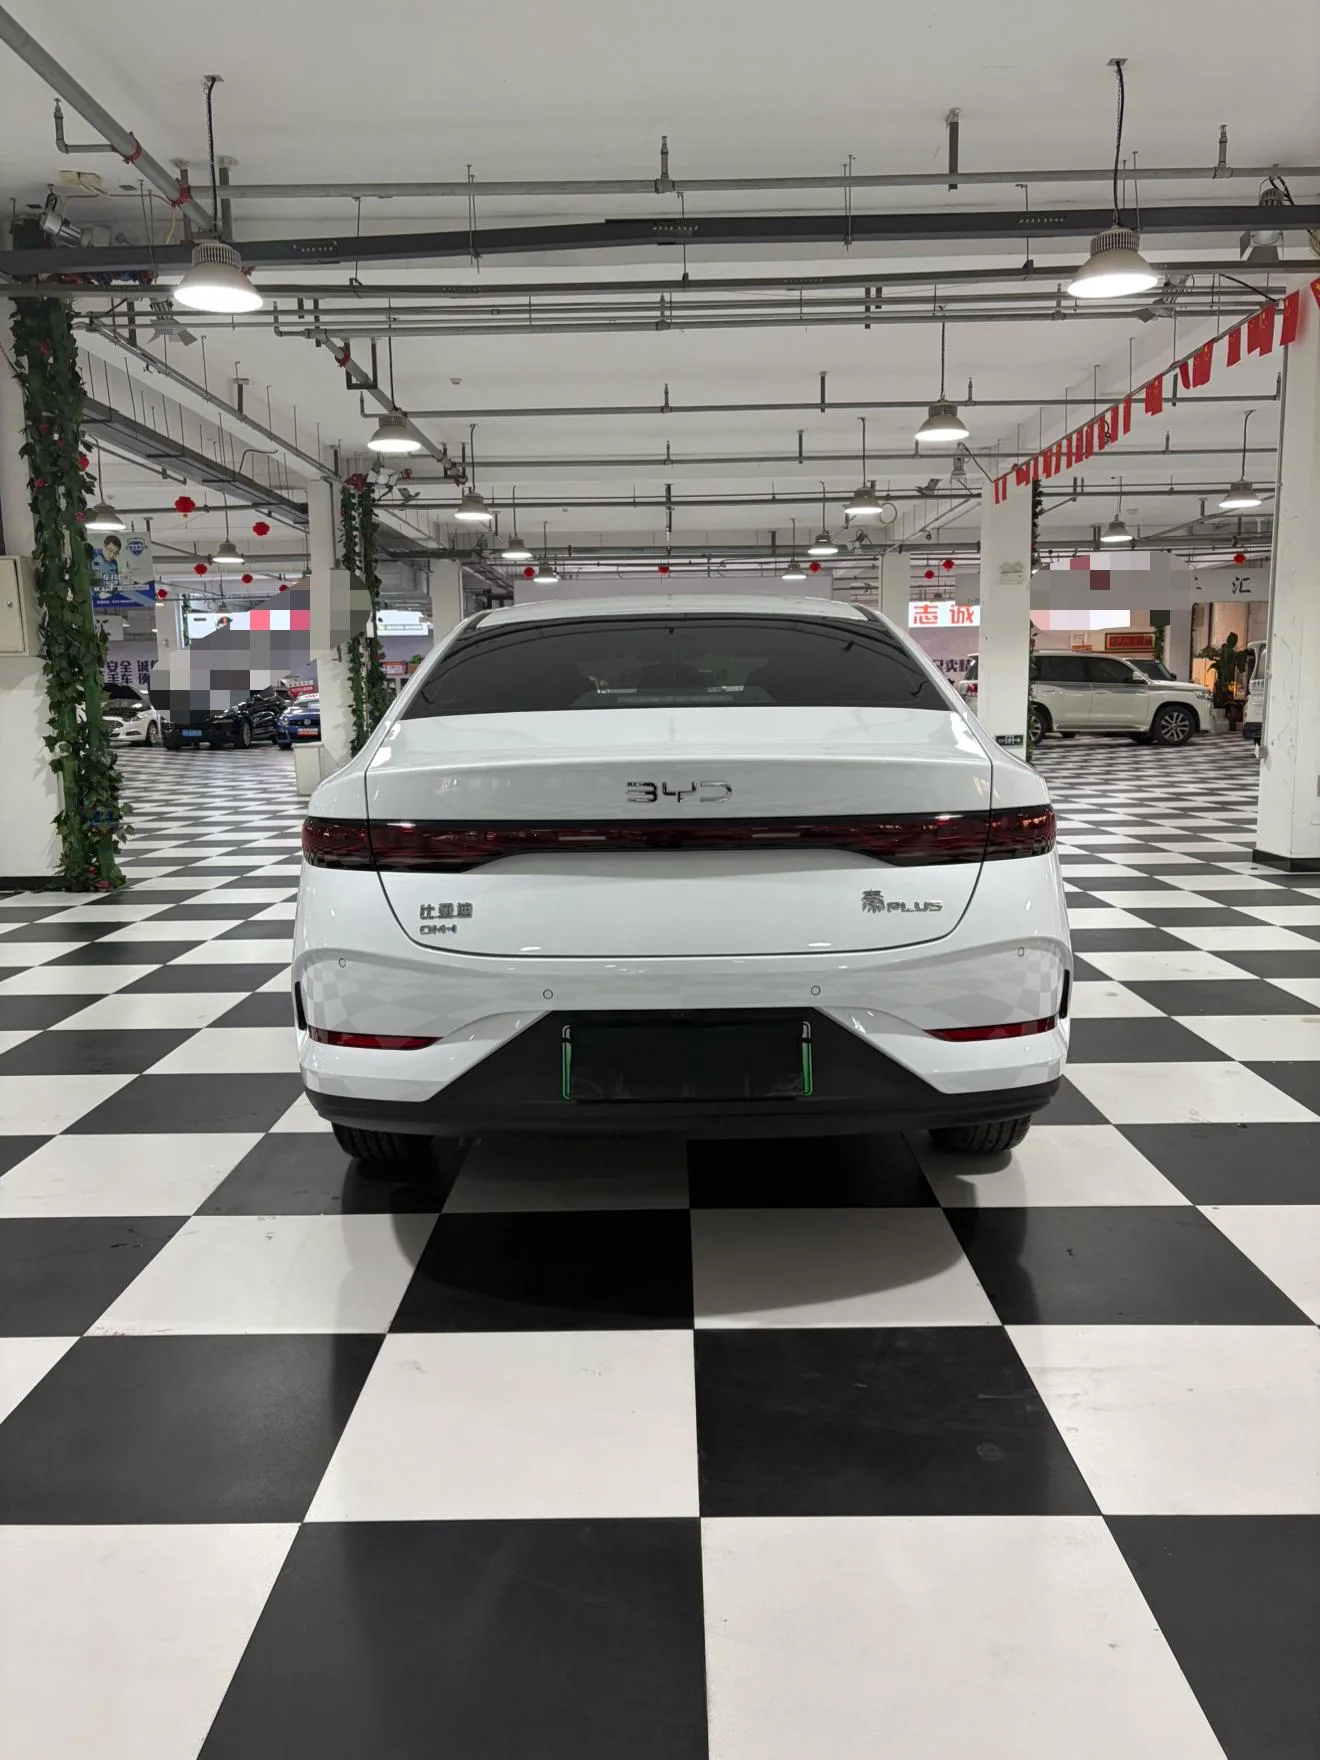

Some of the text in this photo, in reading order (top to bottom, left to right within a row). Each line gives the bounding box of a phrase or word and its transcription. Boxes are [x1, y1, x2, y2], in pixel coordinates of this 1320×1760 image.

[1232, 576, 1251, 594] 汇
[913, 604, 974, 624] 志诚
[626, 781, 733, 803] BYD
[420, 902, 473, 920] 比亚迪
